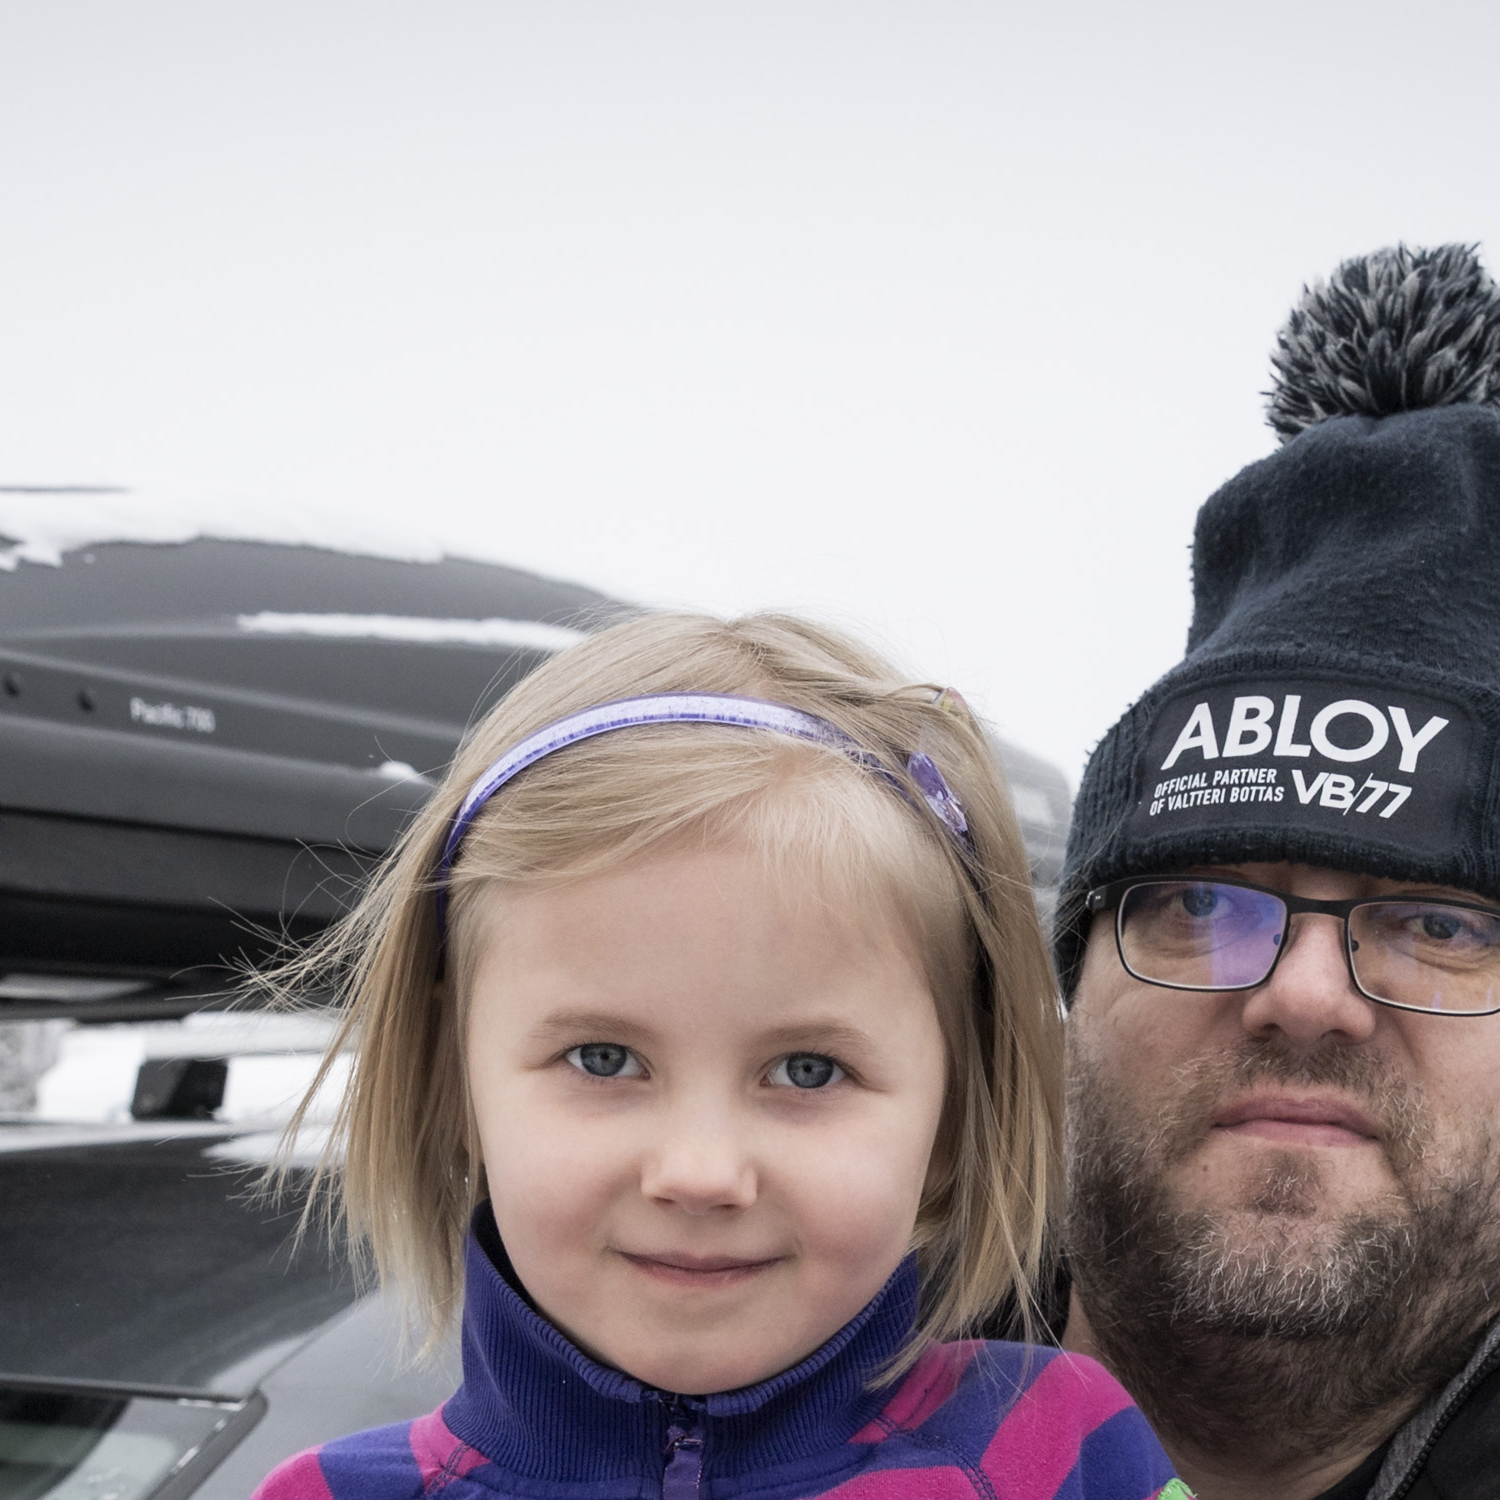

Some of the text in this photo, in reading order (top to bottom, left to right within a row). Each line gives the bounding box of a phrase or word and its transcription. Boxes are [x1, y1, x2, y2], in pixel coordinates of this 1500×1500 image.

[1160, 694, 1449, 773] ABLOY
[1153, 767, 1278, 799] OFFICIAL PARTNER
[1149, 785, 1285, 817] OF VALTTERI BOTTAS
